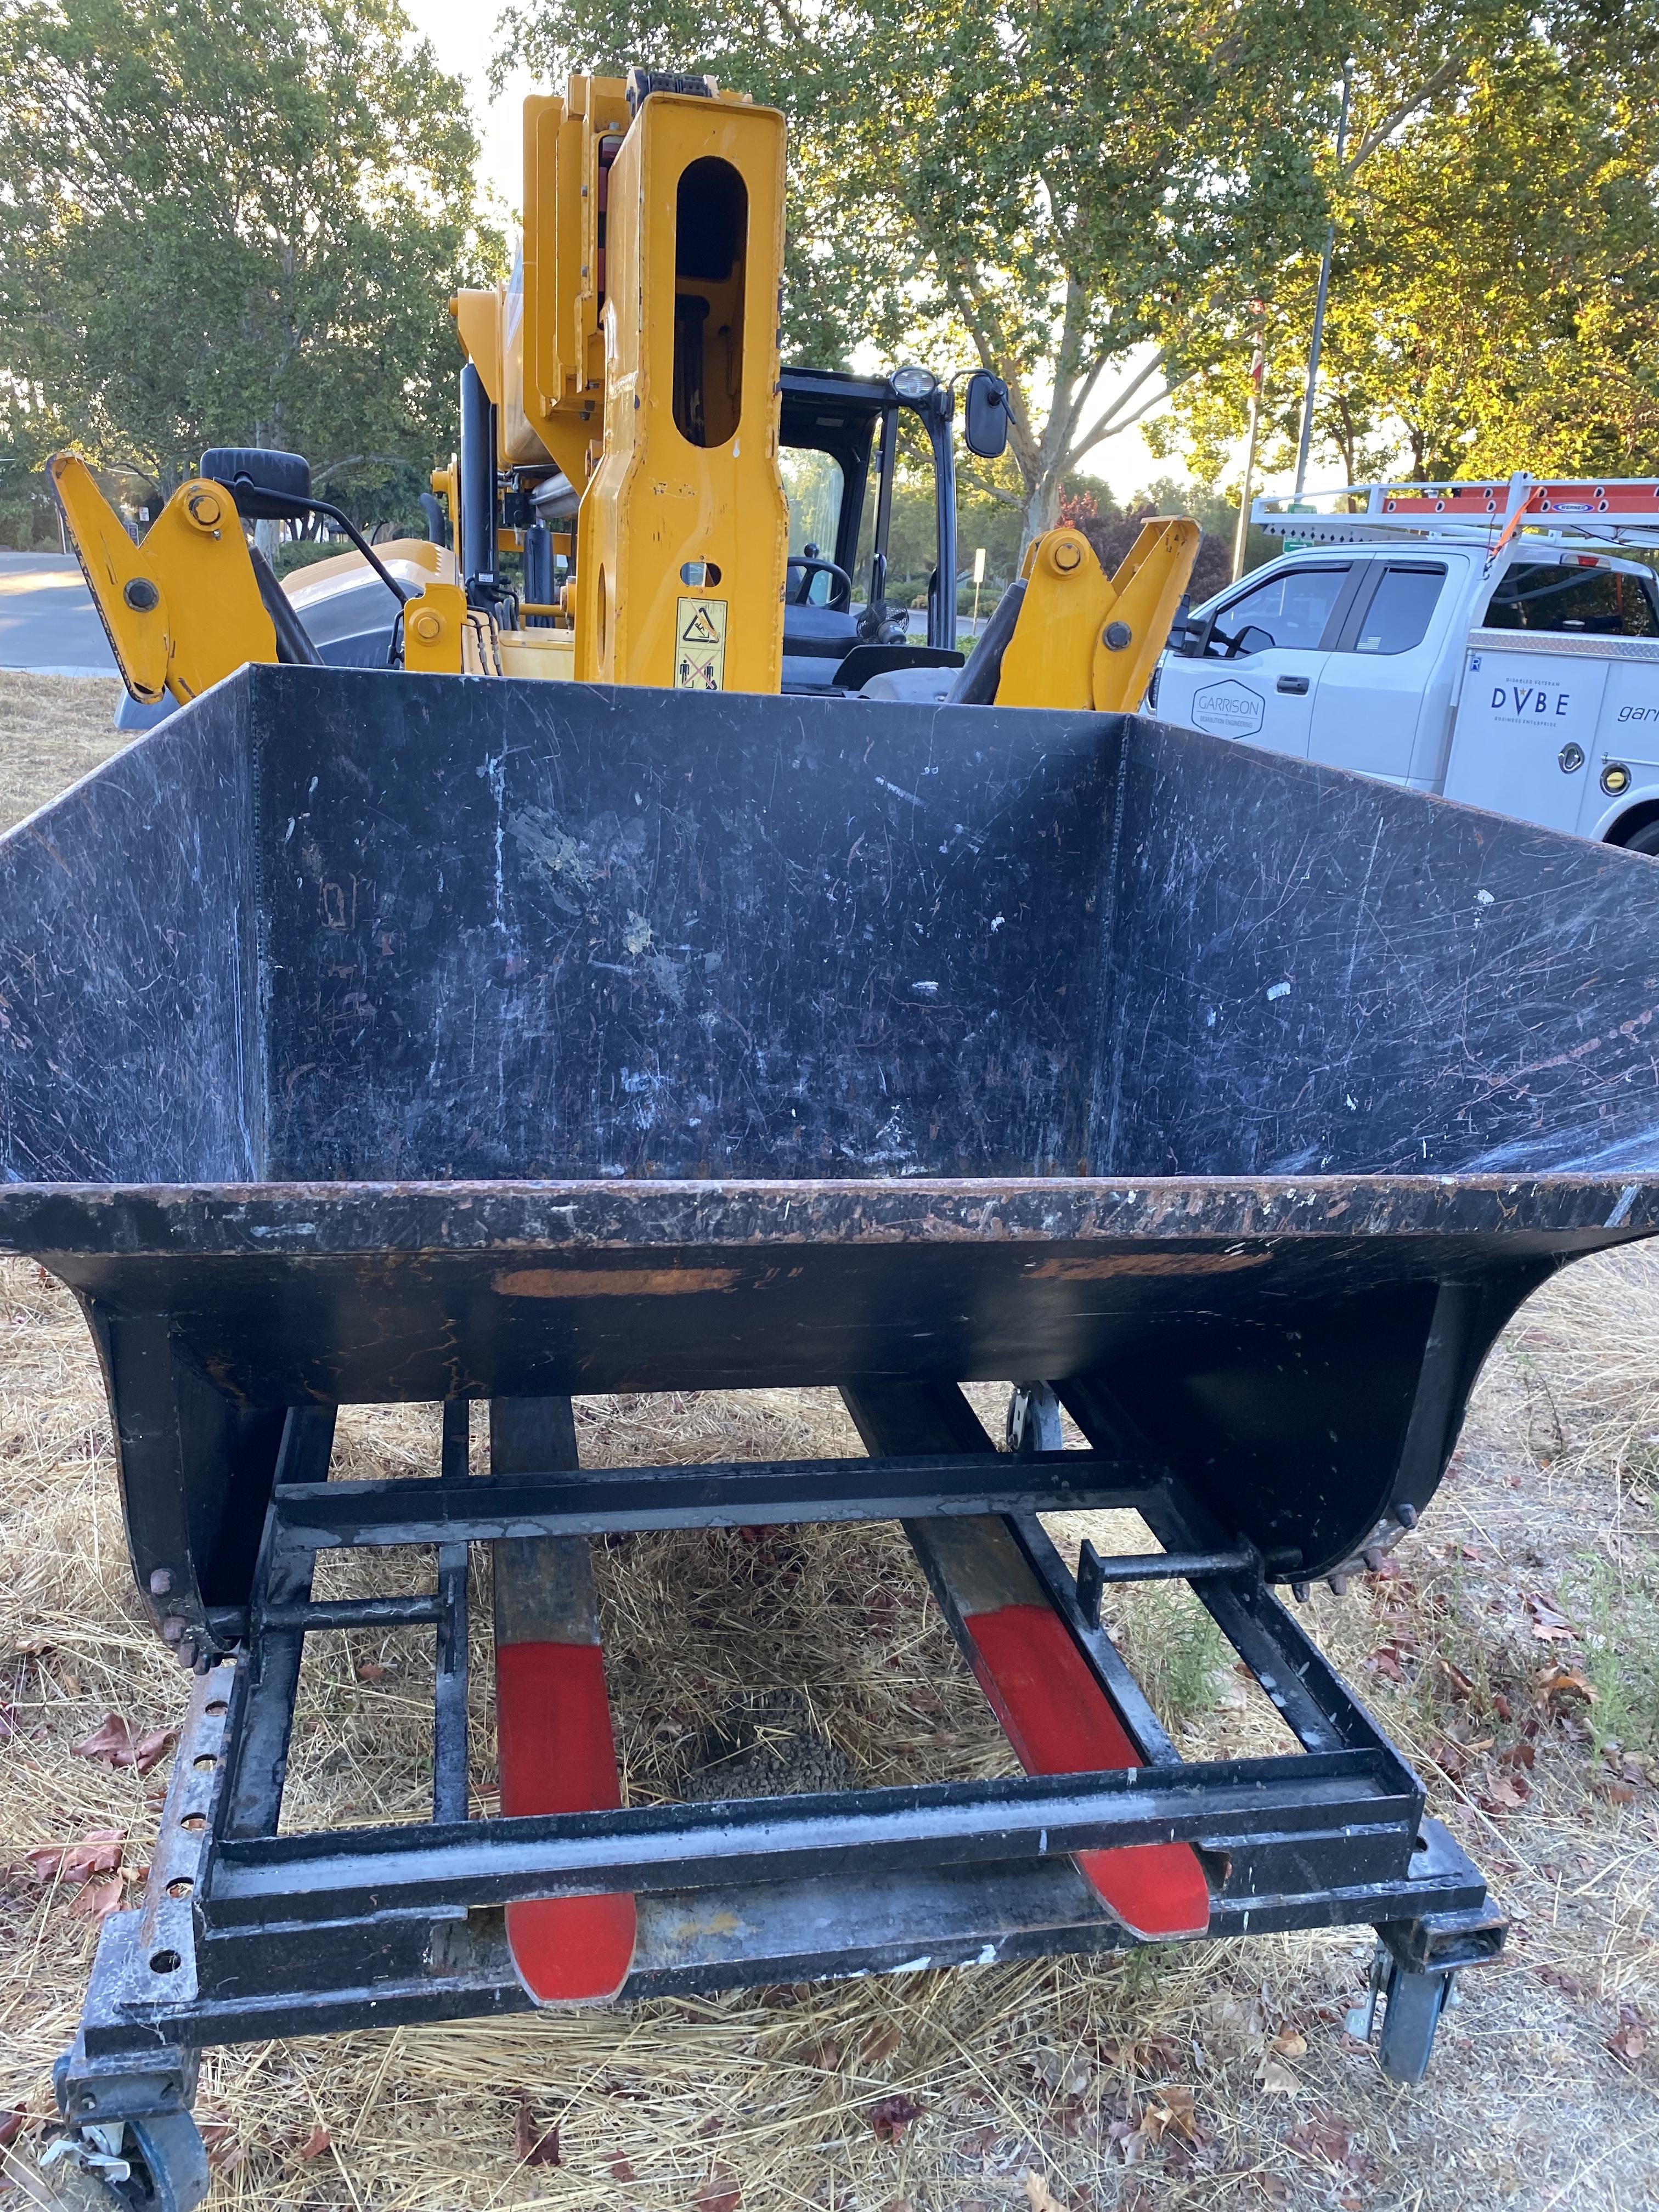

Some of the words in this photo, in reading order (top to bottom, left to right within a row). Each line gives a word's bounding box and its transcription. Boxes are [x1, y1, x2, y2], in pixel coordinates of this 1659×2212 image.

[1471, 658, 1480, 669] R
[1199, 696, 1259, 715] GARRISON
[1491, 687, 1570, 716] DVBE
[1200, 715, 1224, 724] DEMOLITION
[1225, 719, 1252, 729] ENGINEERING
